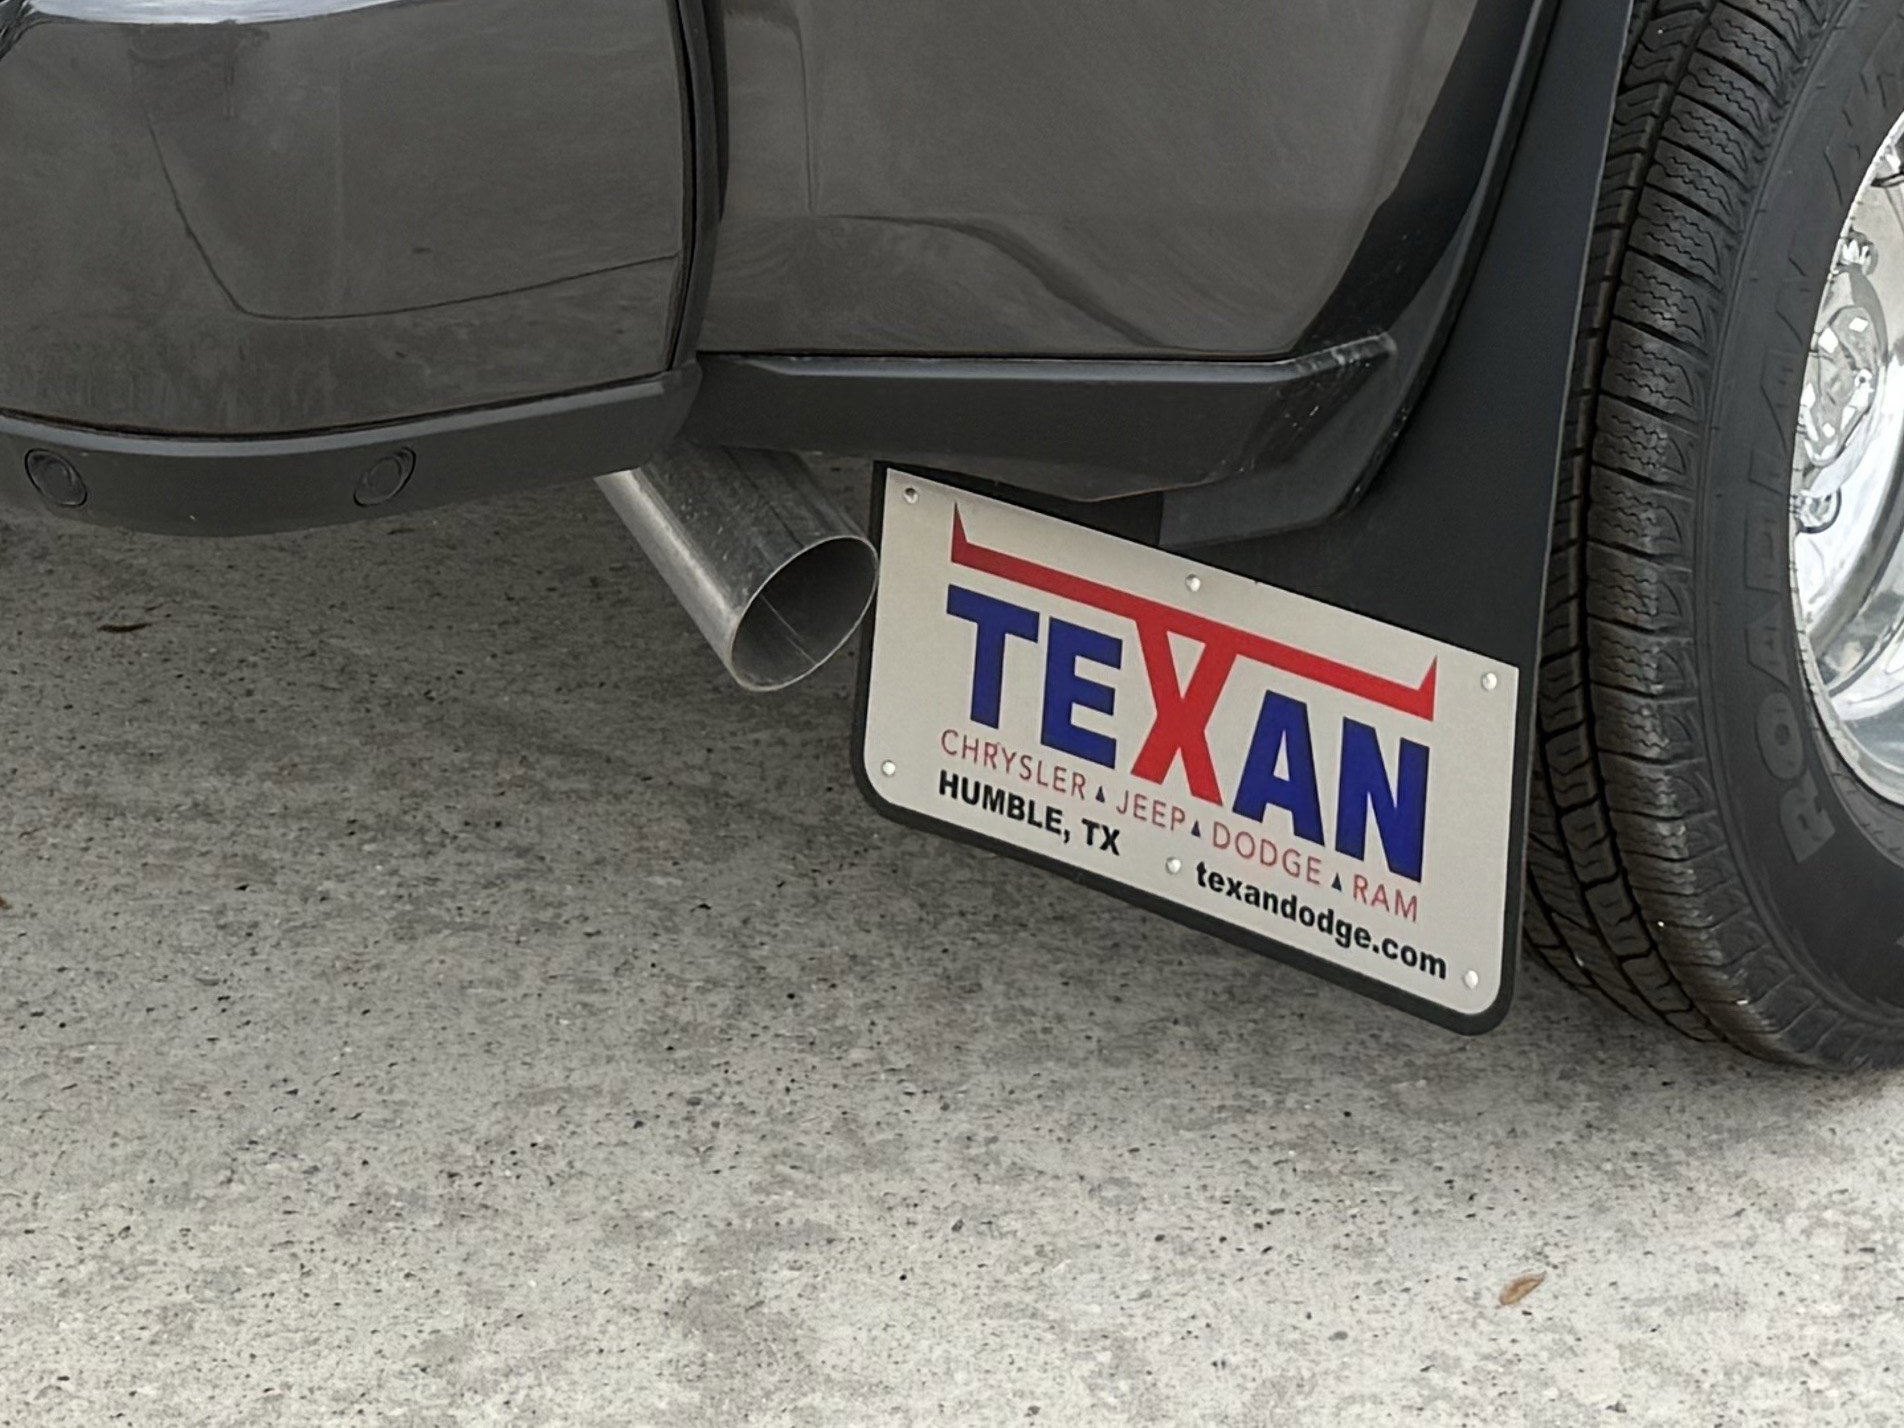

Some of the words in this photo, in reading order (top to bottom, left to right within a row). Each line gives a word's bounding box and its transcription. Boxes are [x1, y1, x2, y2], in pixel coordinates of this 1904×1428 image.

[945, 574, 1432, 884] TEXAN
[938, 769, 1071, 844] HUMBLE,
[1080, 817, 1121, 857] TX
[940, 728, 1087, 800] CHRYSLER
[1115, 789, 1186, 831] JEEP
[1211, 820, 1323, 886] DODGE
[1352, 873, 1419, 924] RAM
[1195, 860, 1448, 981] texandodge.com
